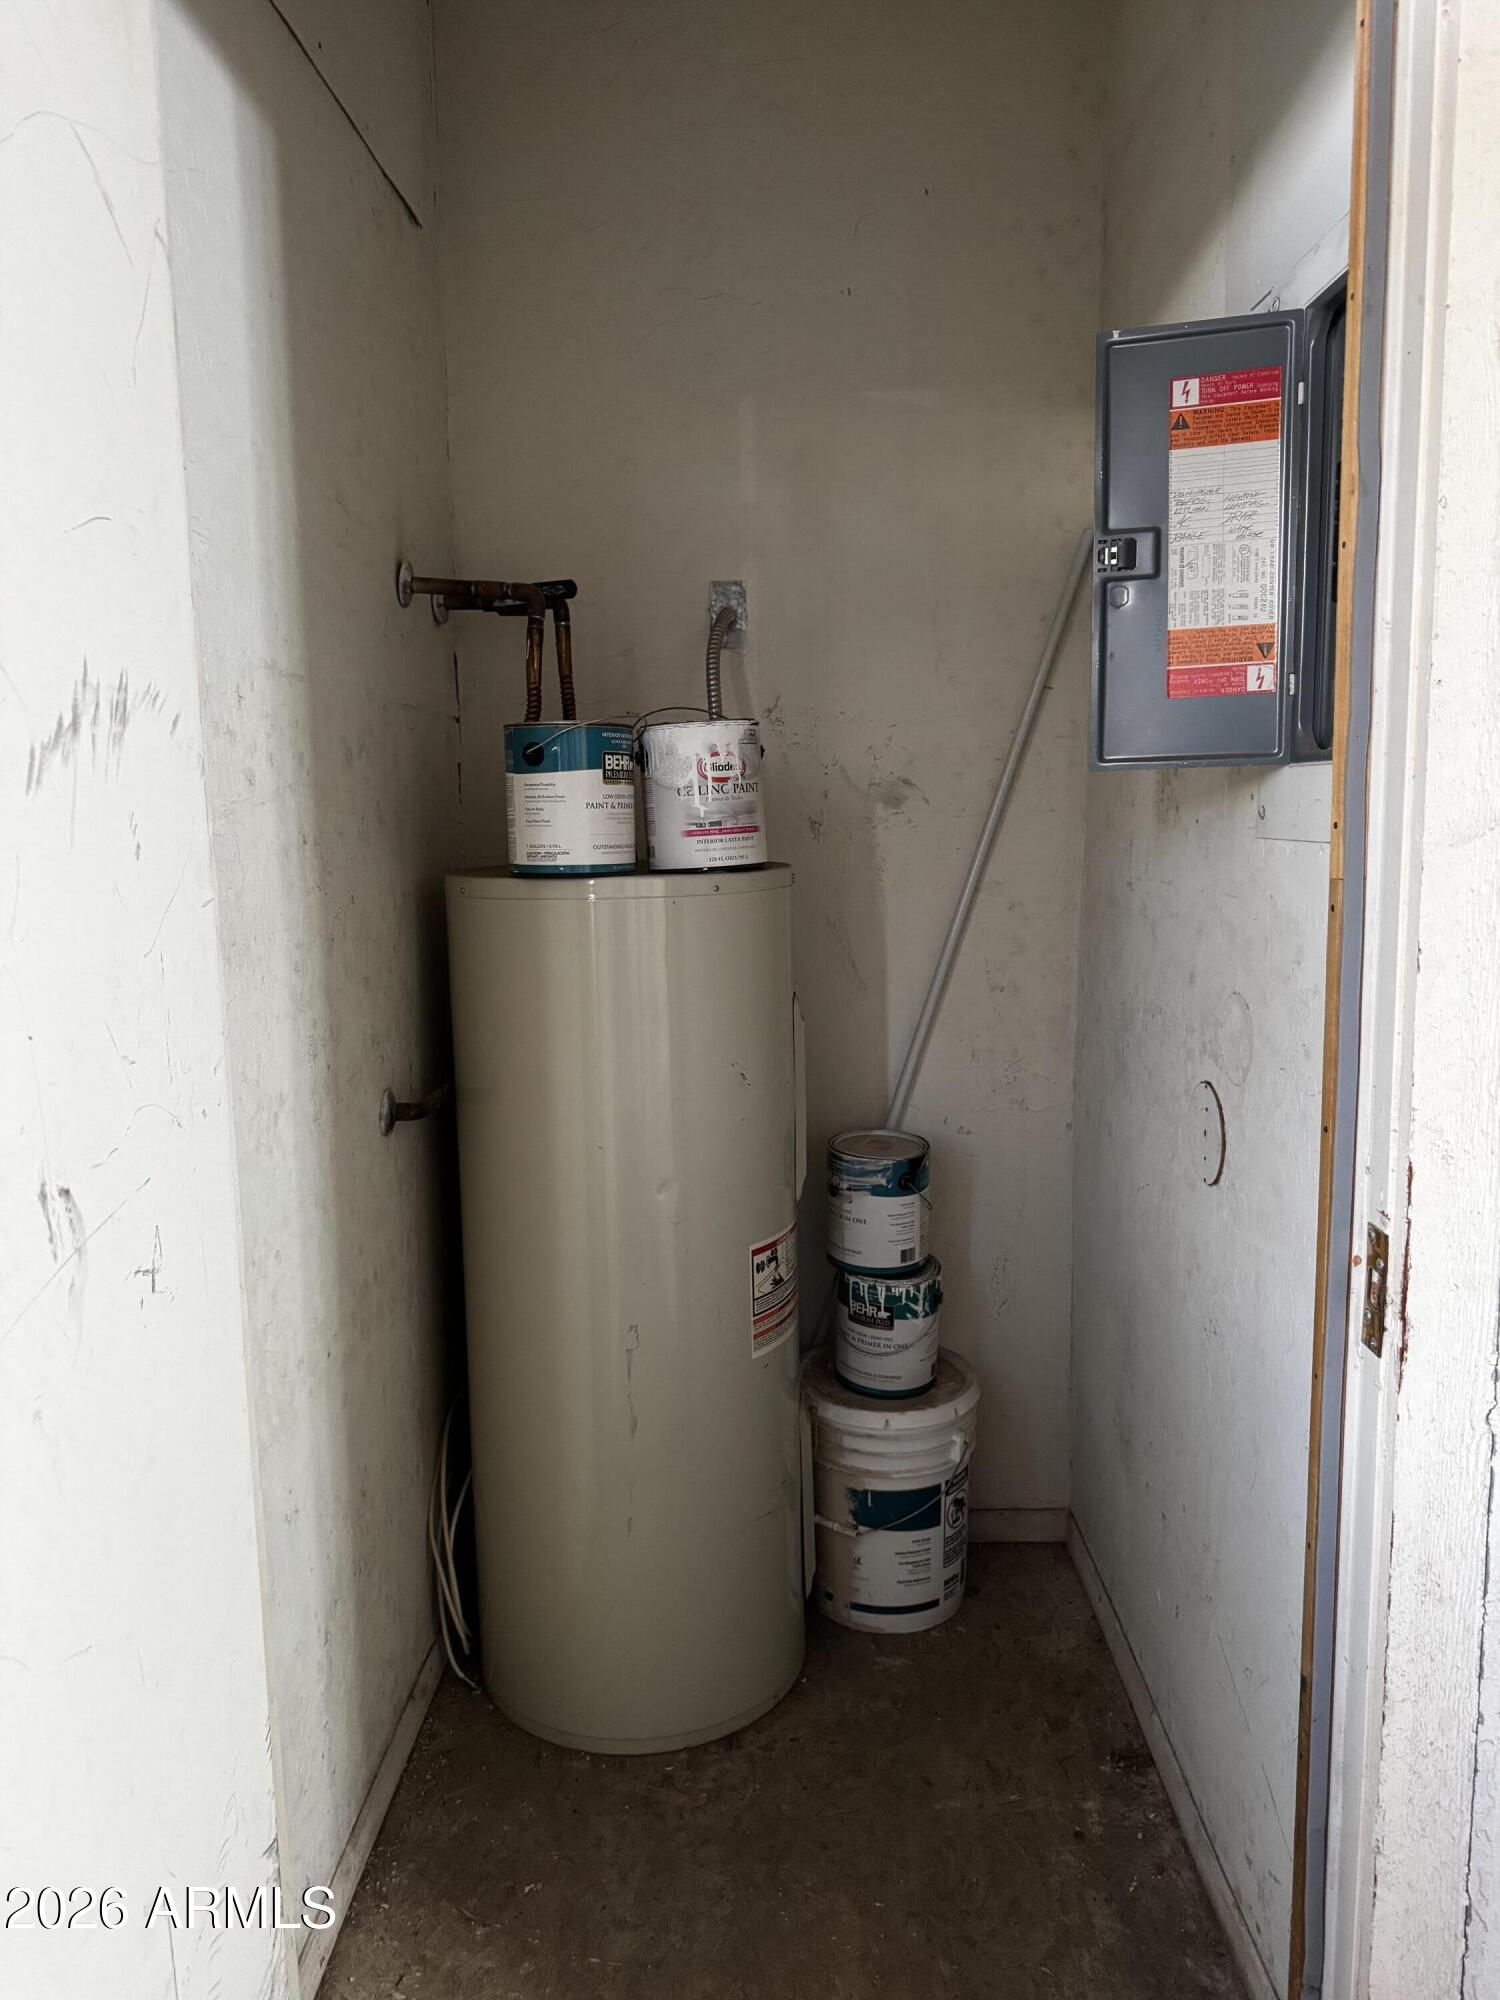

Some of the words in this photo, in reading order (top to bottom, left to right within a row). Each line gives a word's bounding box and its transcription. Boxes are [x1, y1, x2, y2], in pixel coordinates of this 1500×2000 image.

[1200, 374, 1227, 384] DANGER
[1233, 382, 1254, 392] POWER
[733, 782, 759, 794] PAINT
[585, 801, 608, 810] PAINT
[610, 801, 616, 809] &
[850, 1301, 878, 1318] BEHR
[857, 1337, 881, 1349] PRIMER
